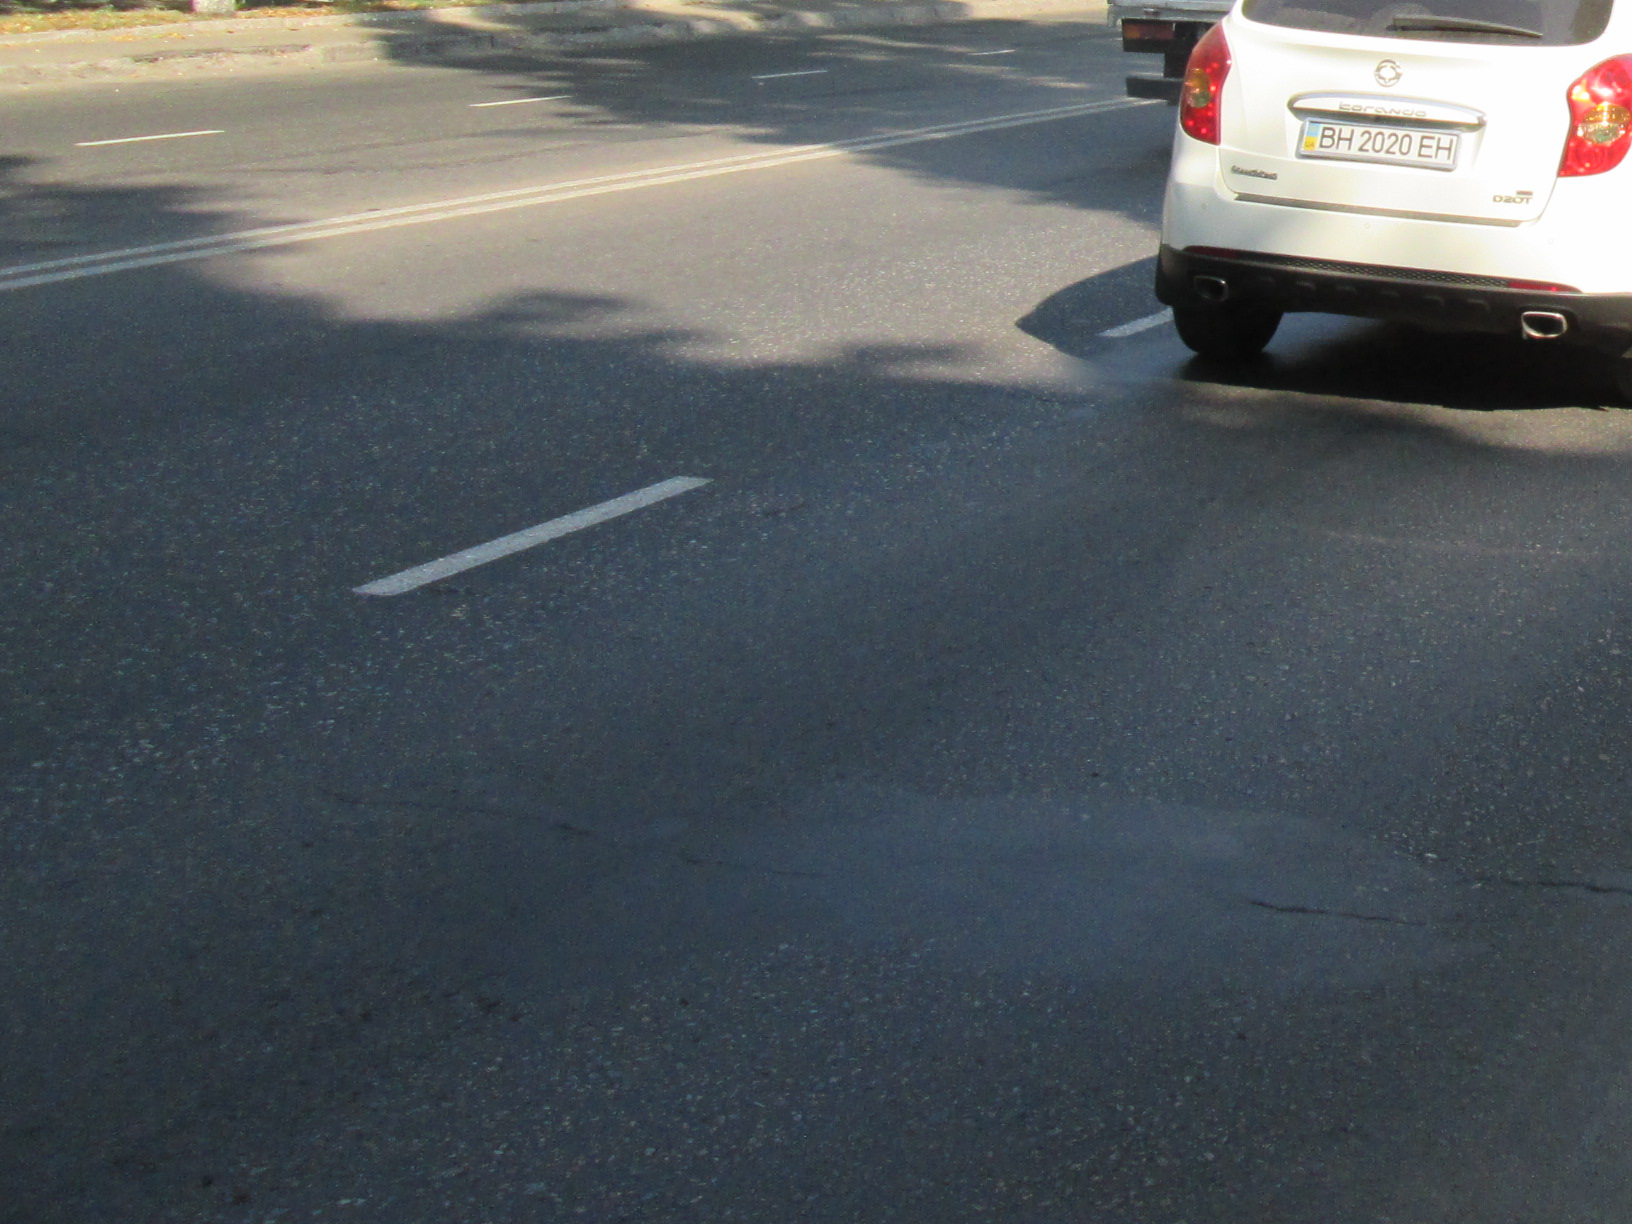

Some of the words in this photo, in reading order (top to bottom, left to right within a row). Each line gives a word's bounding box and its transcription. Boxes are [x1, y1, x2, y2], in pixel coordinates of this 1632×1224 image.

[1319, 126, 1355, 151] BH
[1358, 129, 1413, 156] 2020
[1418, 135, 1454, 161] EH
